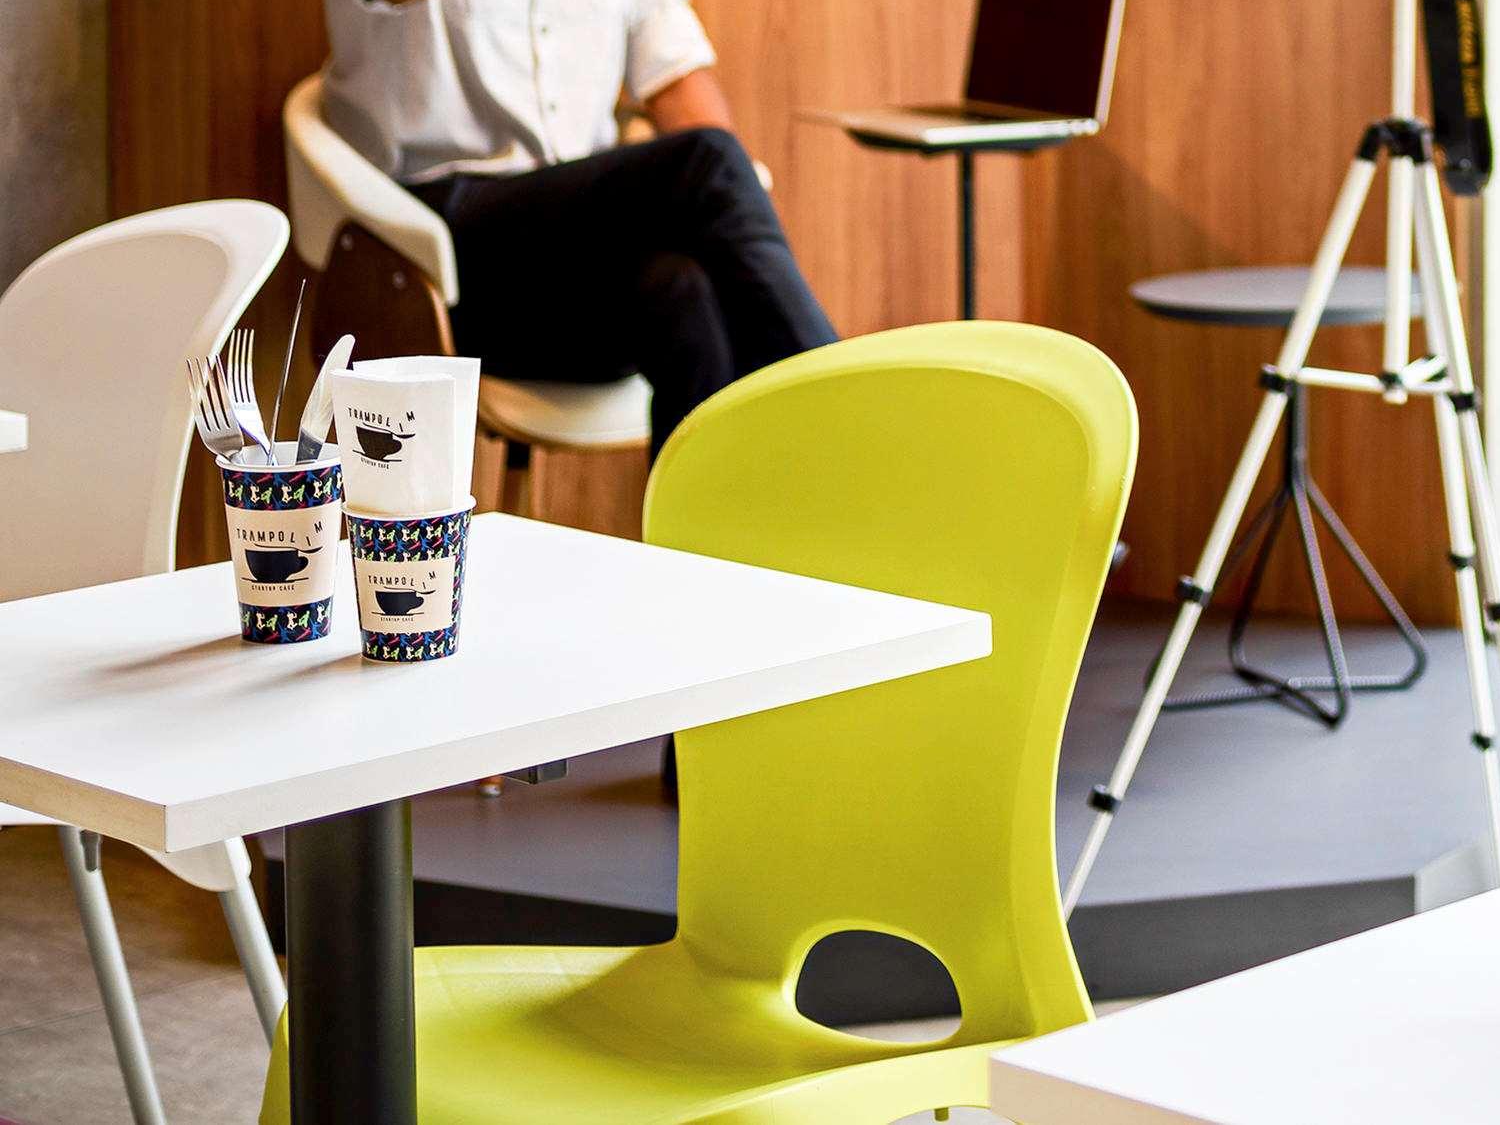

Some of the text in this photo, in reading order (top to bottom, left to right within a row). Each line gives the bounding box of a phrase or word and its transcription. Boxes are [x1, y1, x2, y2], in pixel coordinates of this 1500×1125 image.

[347, 407, 416, 433] TRAMPOLIM
[236, 521, 323, 546] TRAMPOLIM
[368, 571, 437, 590] TRAMPOLIM
